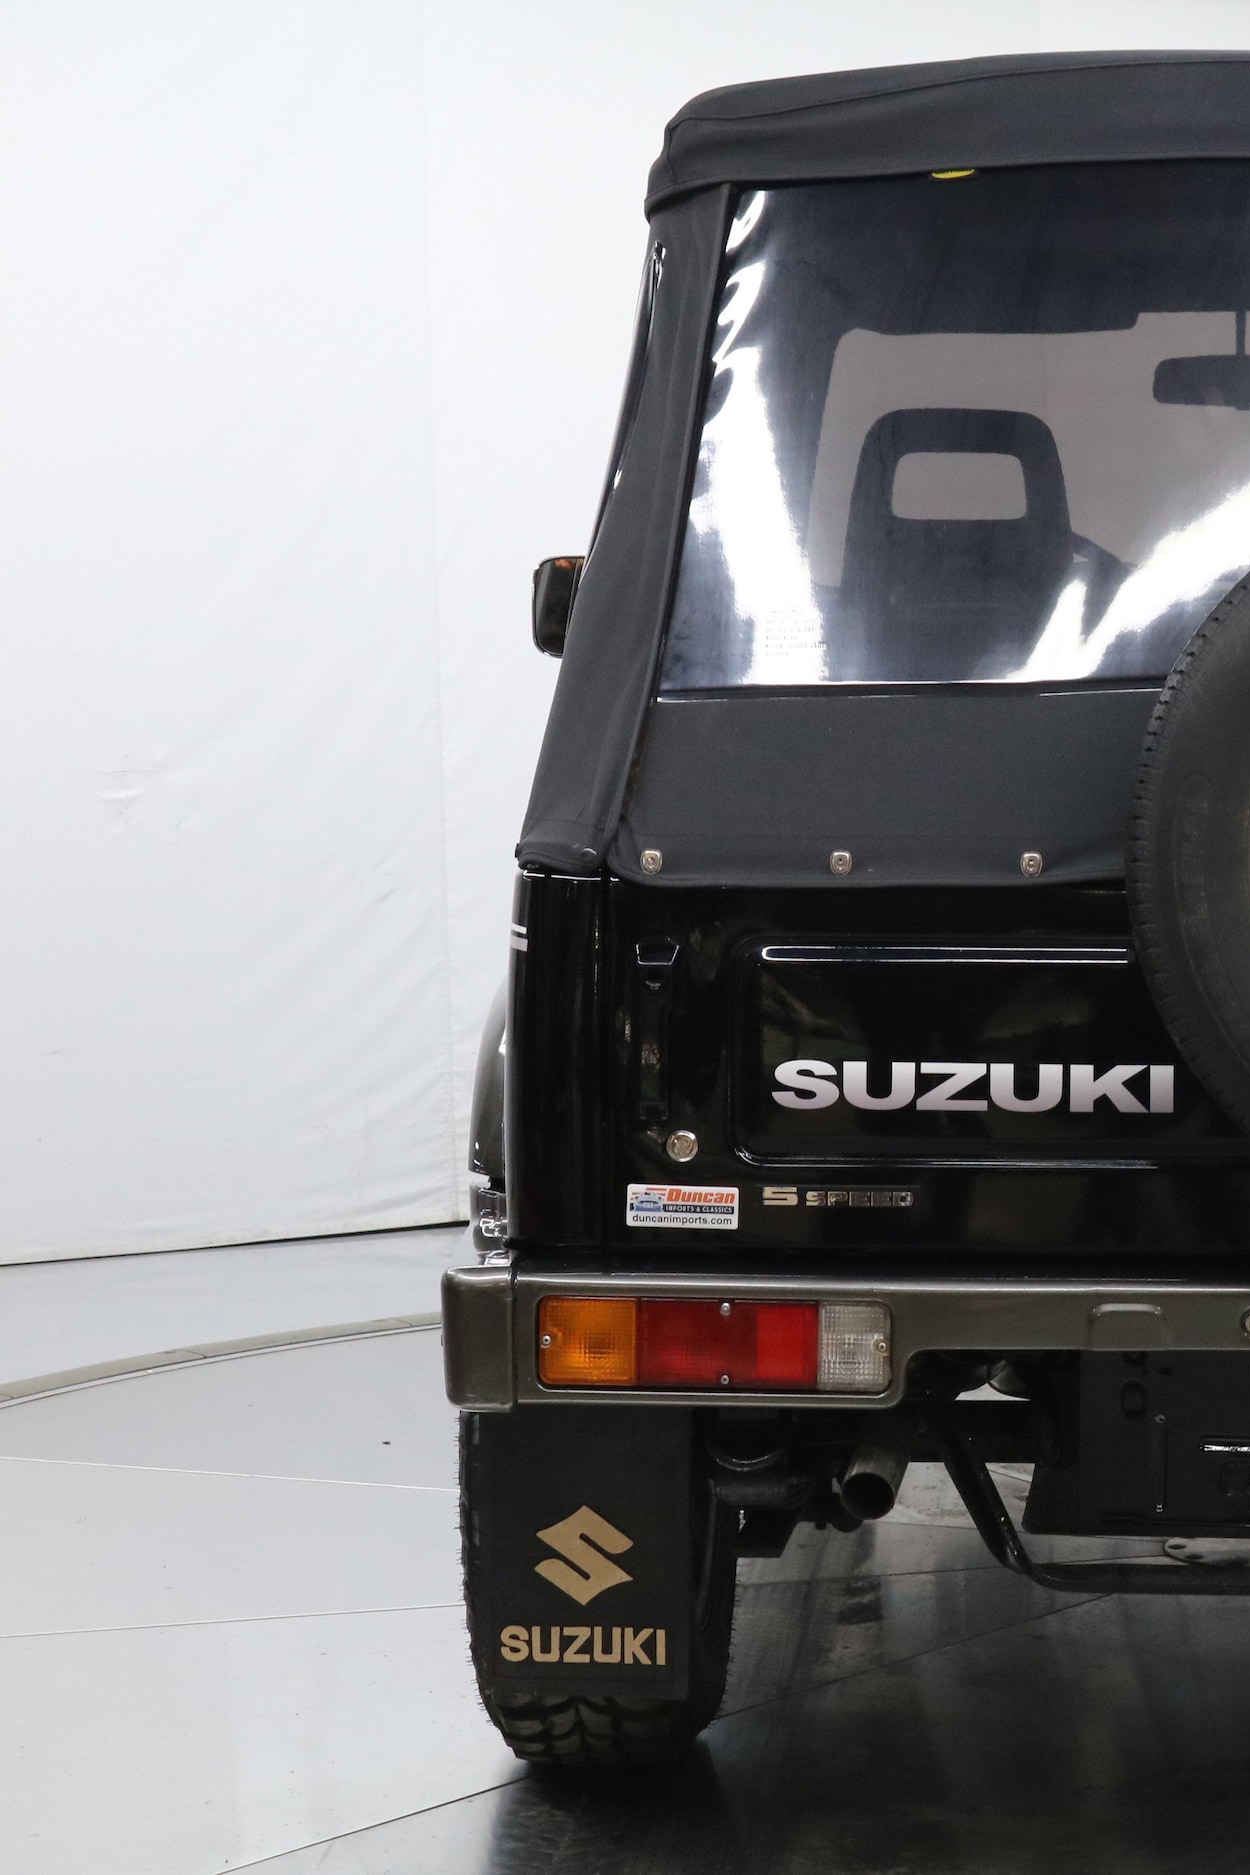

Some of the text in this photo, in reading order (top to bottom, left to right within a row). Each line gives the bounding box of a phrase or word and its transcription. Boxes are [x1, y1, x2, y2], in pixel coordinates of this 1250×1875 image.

[772, 1060, 1174, 1111] SUZUKI
[666, 1188, 736, 1204] Duncan
[763, 1186, 914, 1207] 5 SPEED
[665, 1204, 695, 1213] IMPORTS
[702, 1206, 733, 1214] CLASSICS
[632, 1213, 733, 1226] duncanimports.com
[501, 1626, 665, 1665] SUZUKI
